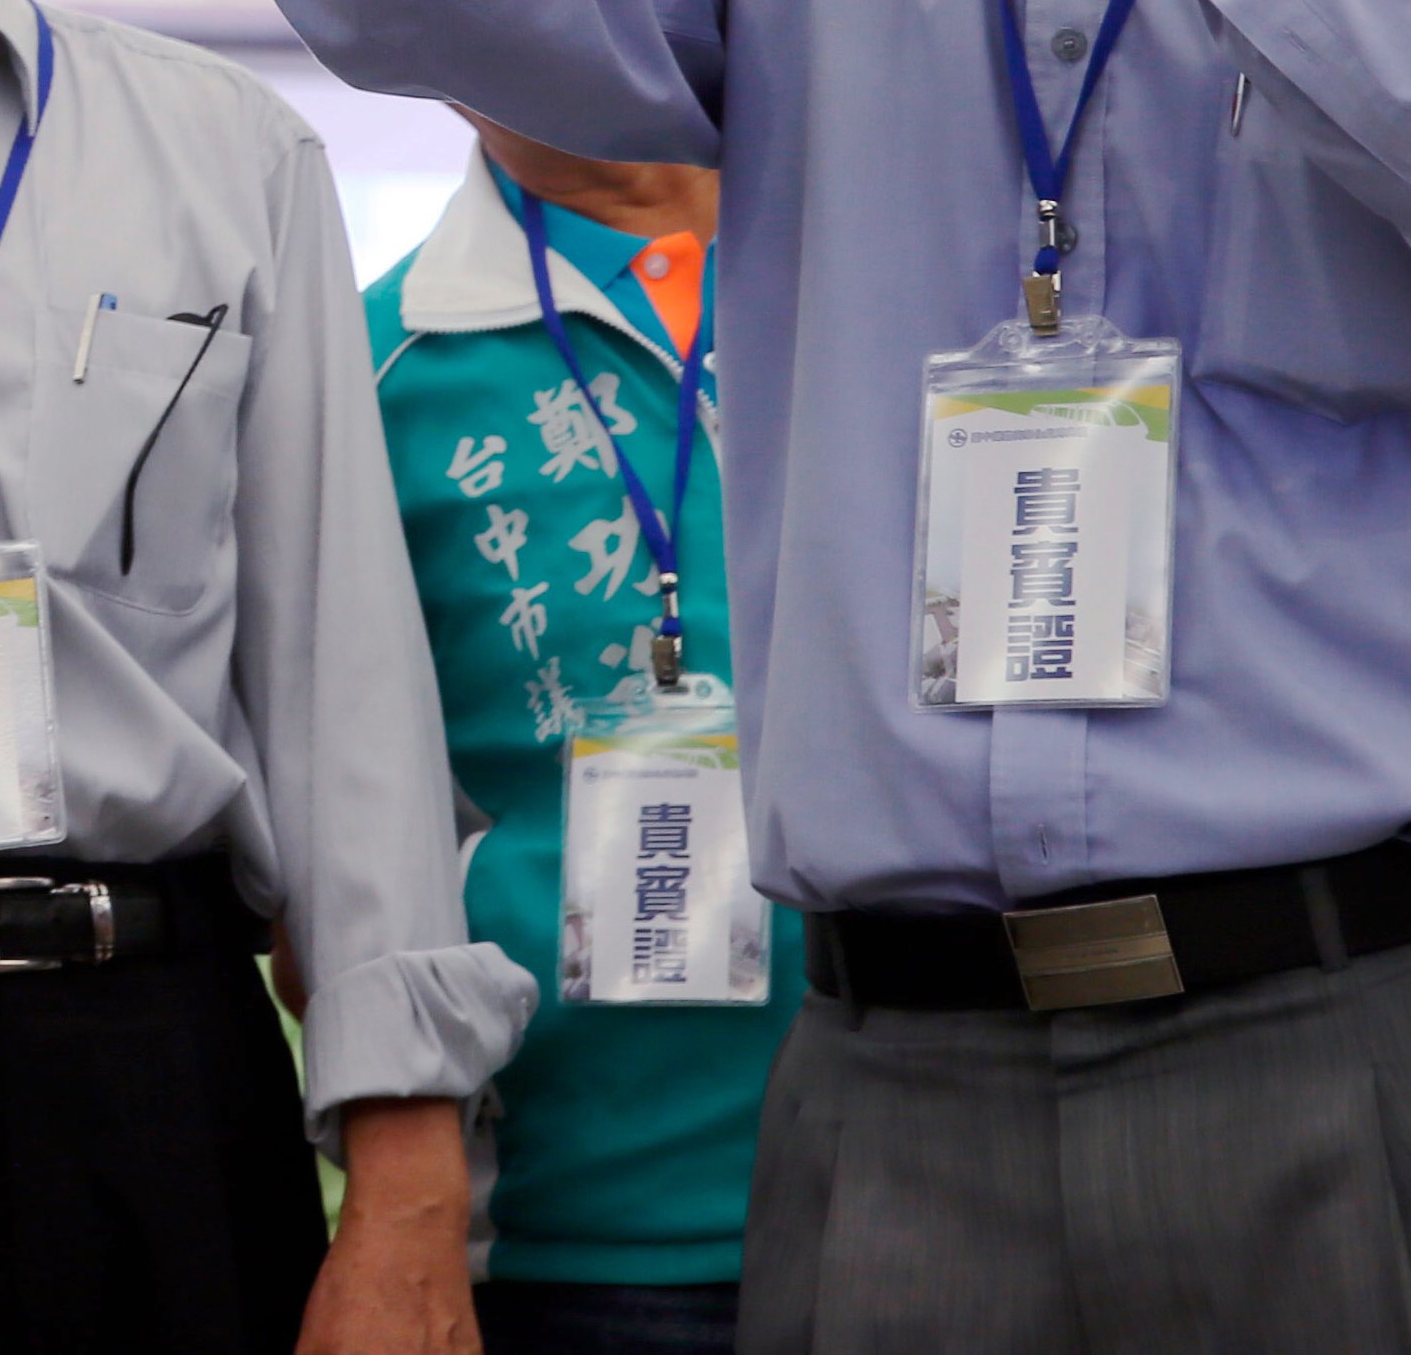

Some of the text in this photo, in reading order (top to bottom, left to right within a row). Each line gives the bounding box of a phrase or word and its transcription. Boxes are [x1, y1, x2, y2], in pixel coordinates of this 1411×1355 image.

[1006, 467, 1081, 683] 貴賓證
[633, 803, 693, 984] 貴賓證
